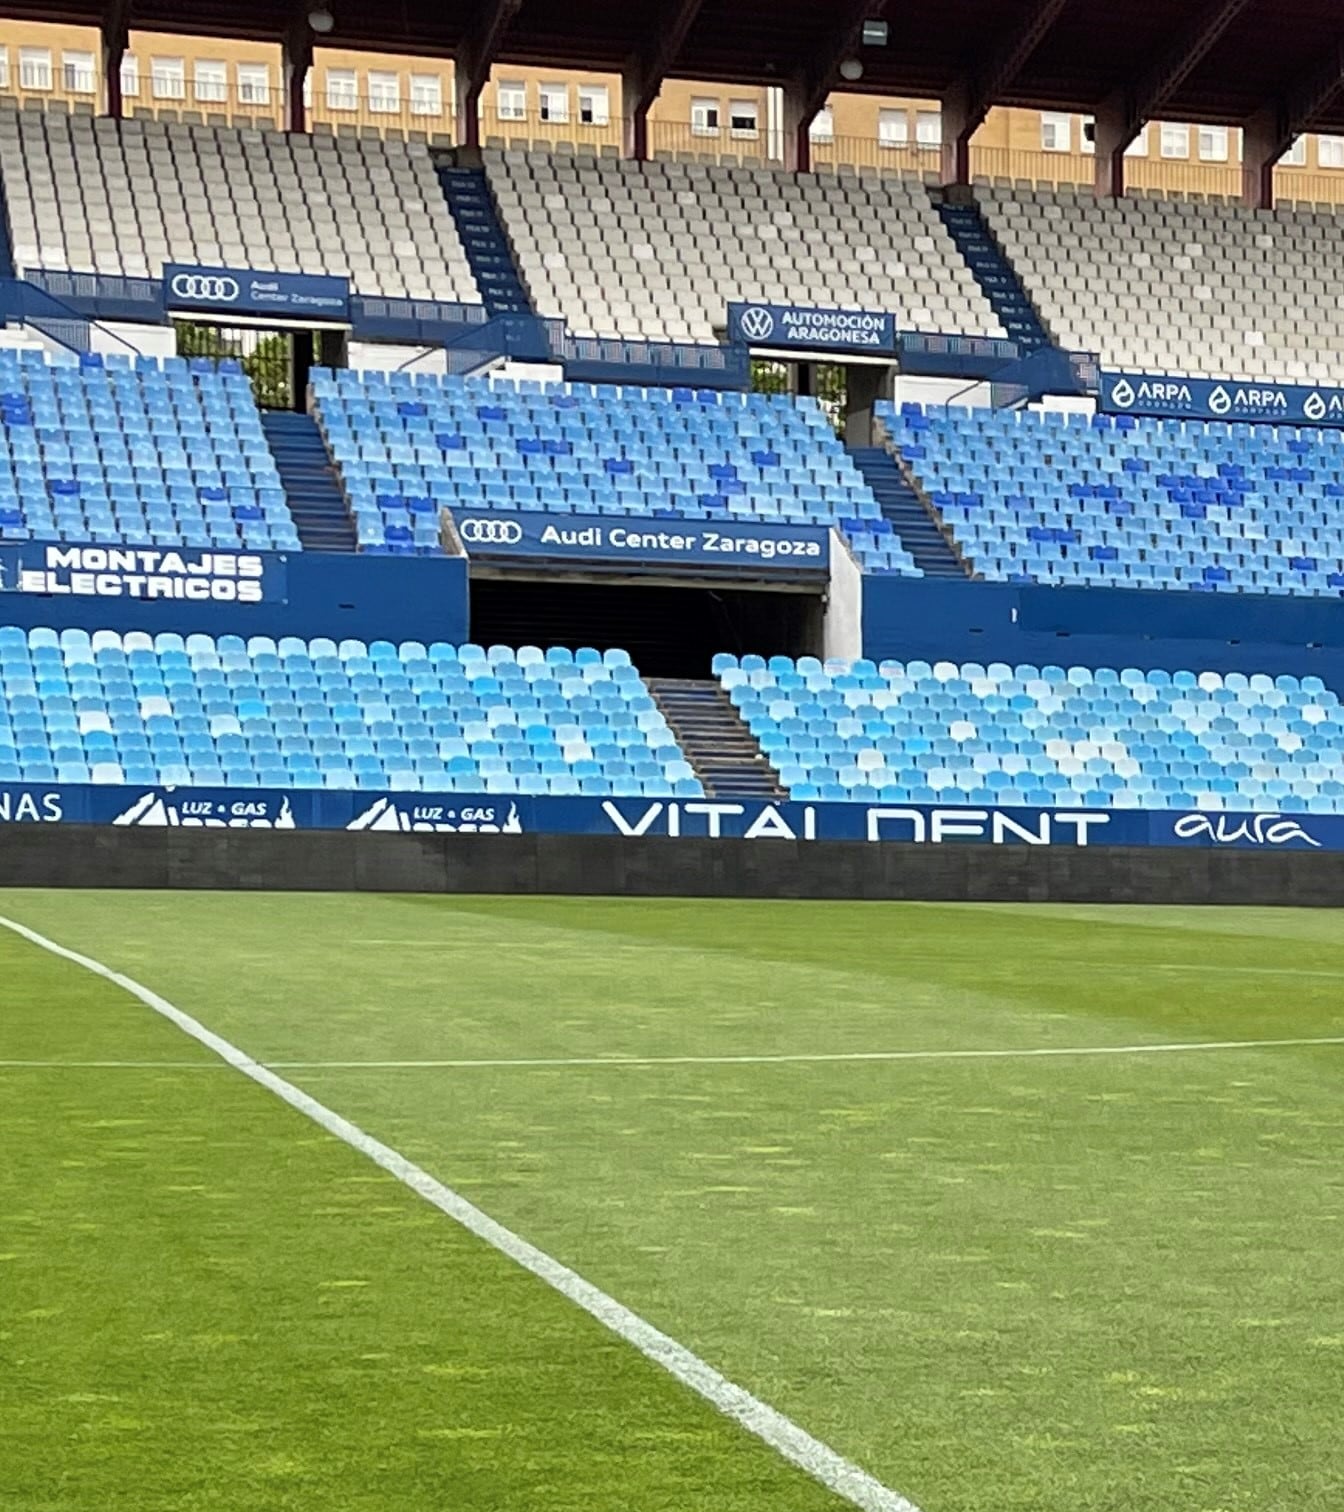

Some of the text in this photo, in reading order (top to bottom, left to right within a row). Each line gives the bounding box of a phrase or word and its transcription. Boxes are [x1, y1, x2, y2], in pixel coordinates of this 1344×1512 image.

[251, 280, 279, 291] Audi
[781, 310, 886, 332] AUTOMOCIÓN
[786, 326, 880, 345] ARAGONESA
[1137, 381, 1192, 402] ARPA
[1234, 387, 1288, 407] ARPA
[541, 524, 821, 558] Audi Center Zaragoza
[45, 546, 263, 577] MONTAJES
[21, 570, 263, 602] ELECTRICOS
[181, 801, 268, 816] LUZ GAS
[413, 806, 495, 822] LUZ GAS
[1174, 814, 1323, 848] aura
